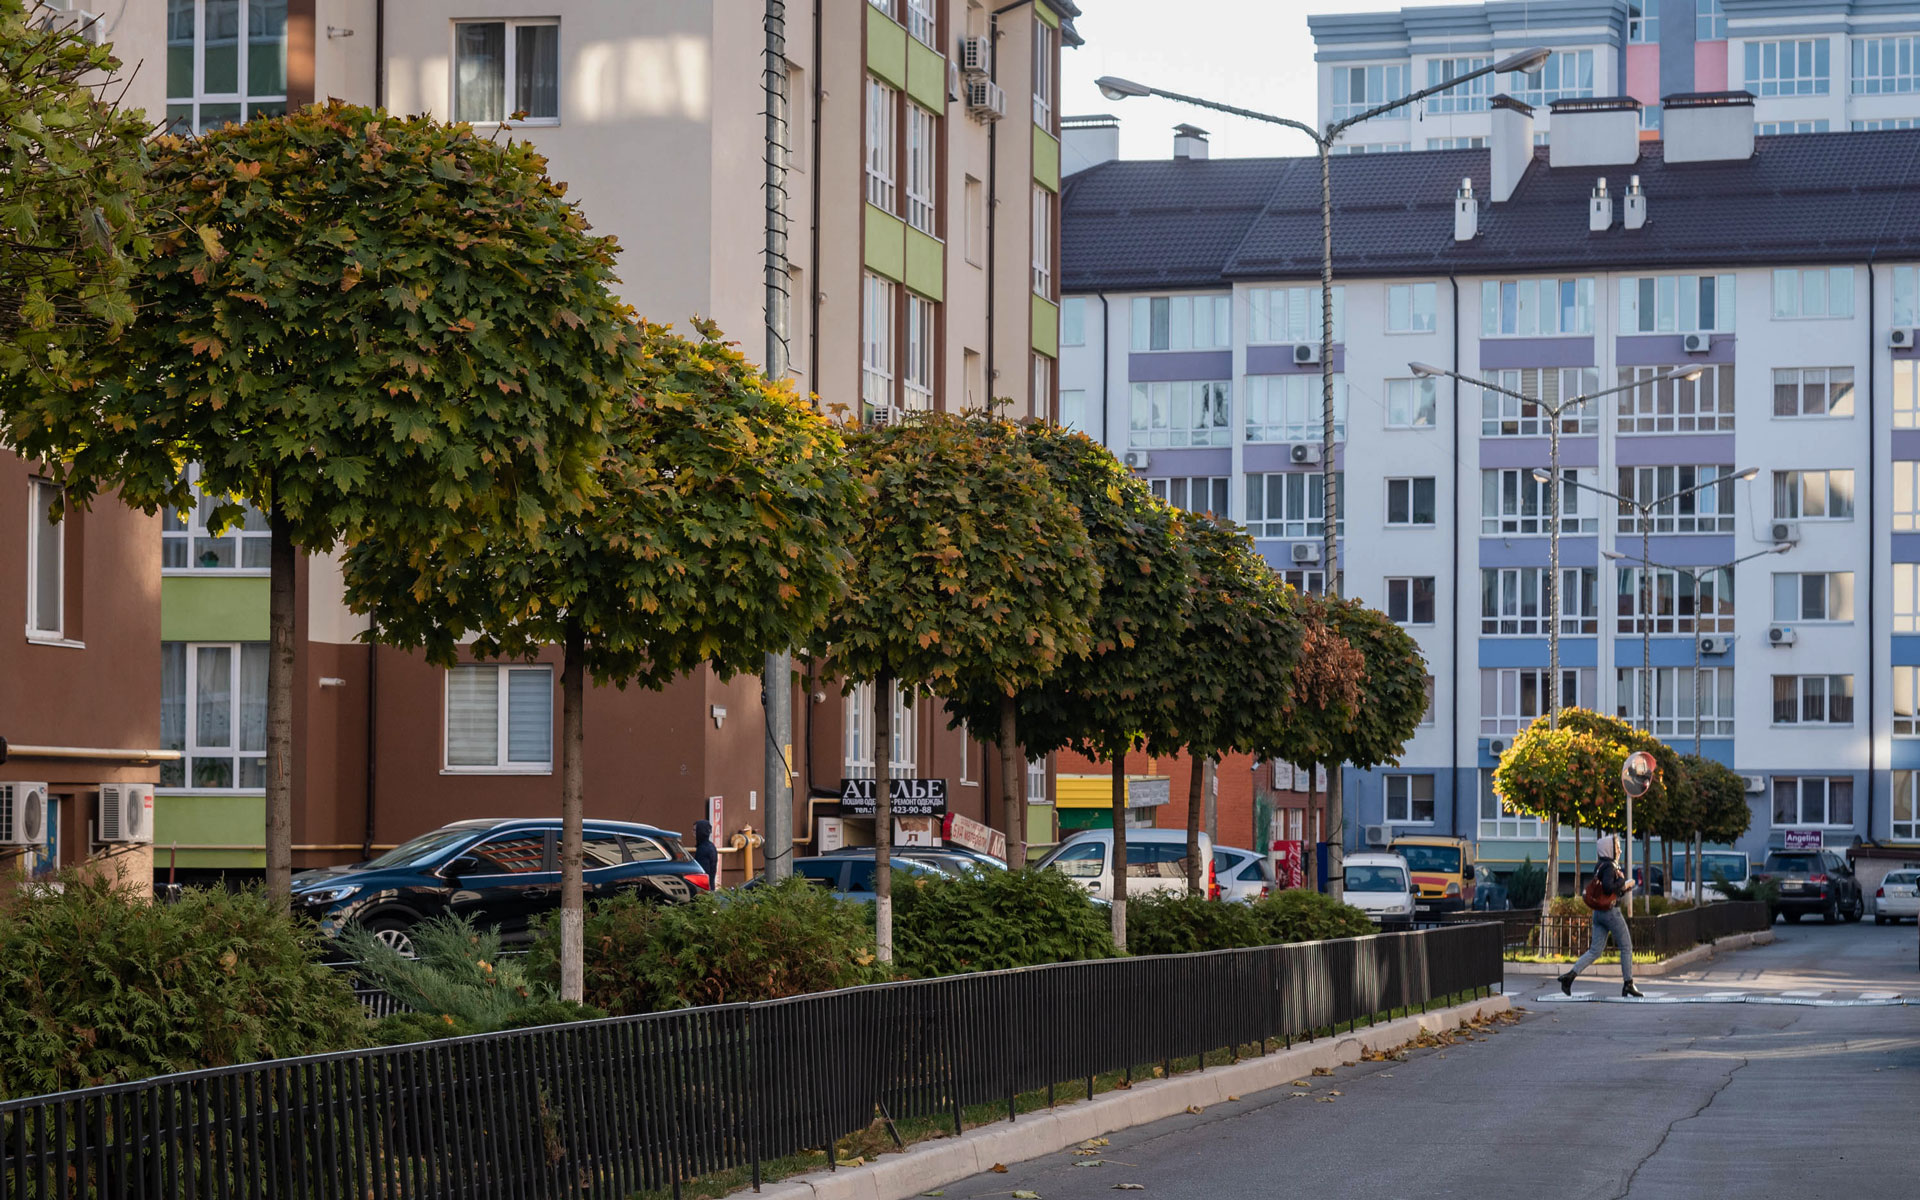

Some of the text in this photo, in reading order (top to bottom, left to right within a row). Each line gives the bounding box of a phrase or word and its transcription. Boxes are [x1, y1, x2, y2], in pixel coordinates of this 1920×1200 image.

[843, 780, 944, 798] АТЛЬЕ
[917, 798, 944, 806] ОДЕЖДЫ
[1787, 834, 1820, 843] Angelina
